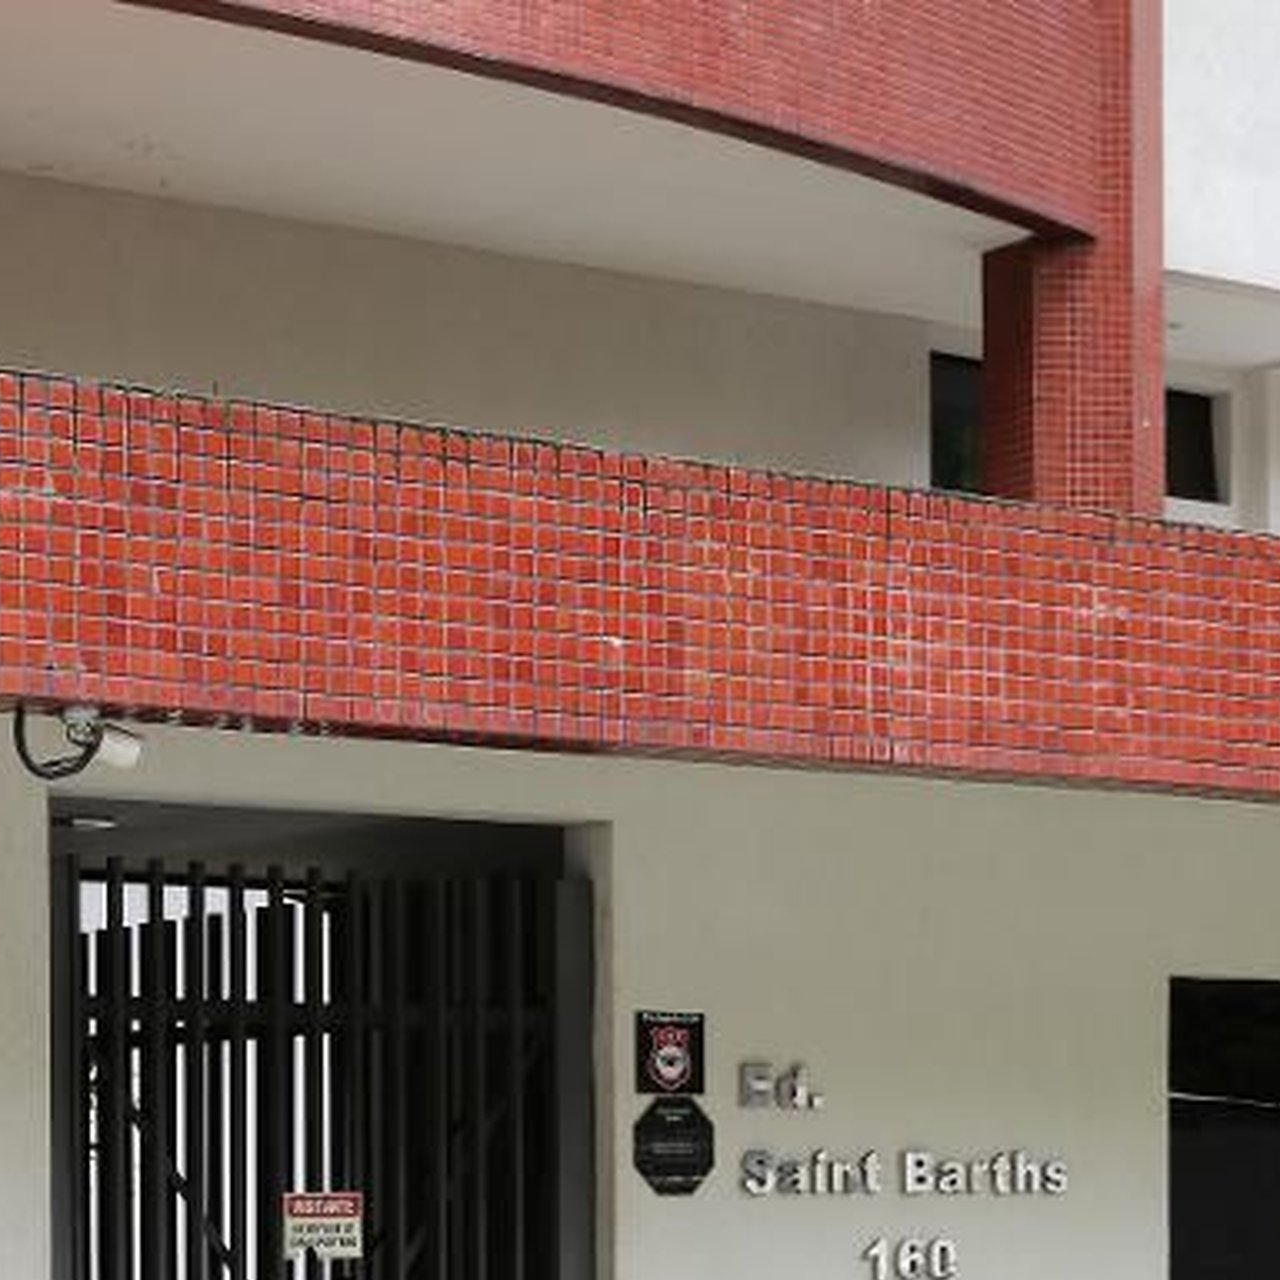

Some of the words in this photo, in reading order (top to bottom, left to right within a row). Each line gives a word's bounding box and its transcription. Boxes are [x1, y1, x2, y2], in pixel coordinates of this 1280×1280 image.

[739, 1062, 824, 1109] Ed.
[740, 1149, 882, 1196] Saint
[900, 1150, 1069, 1195] Barths
